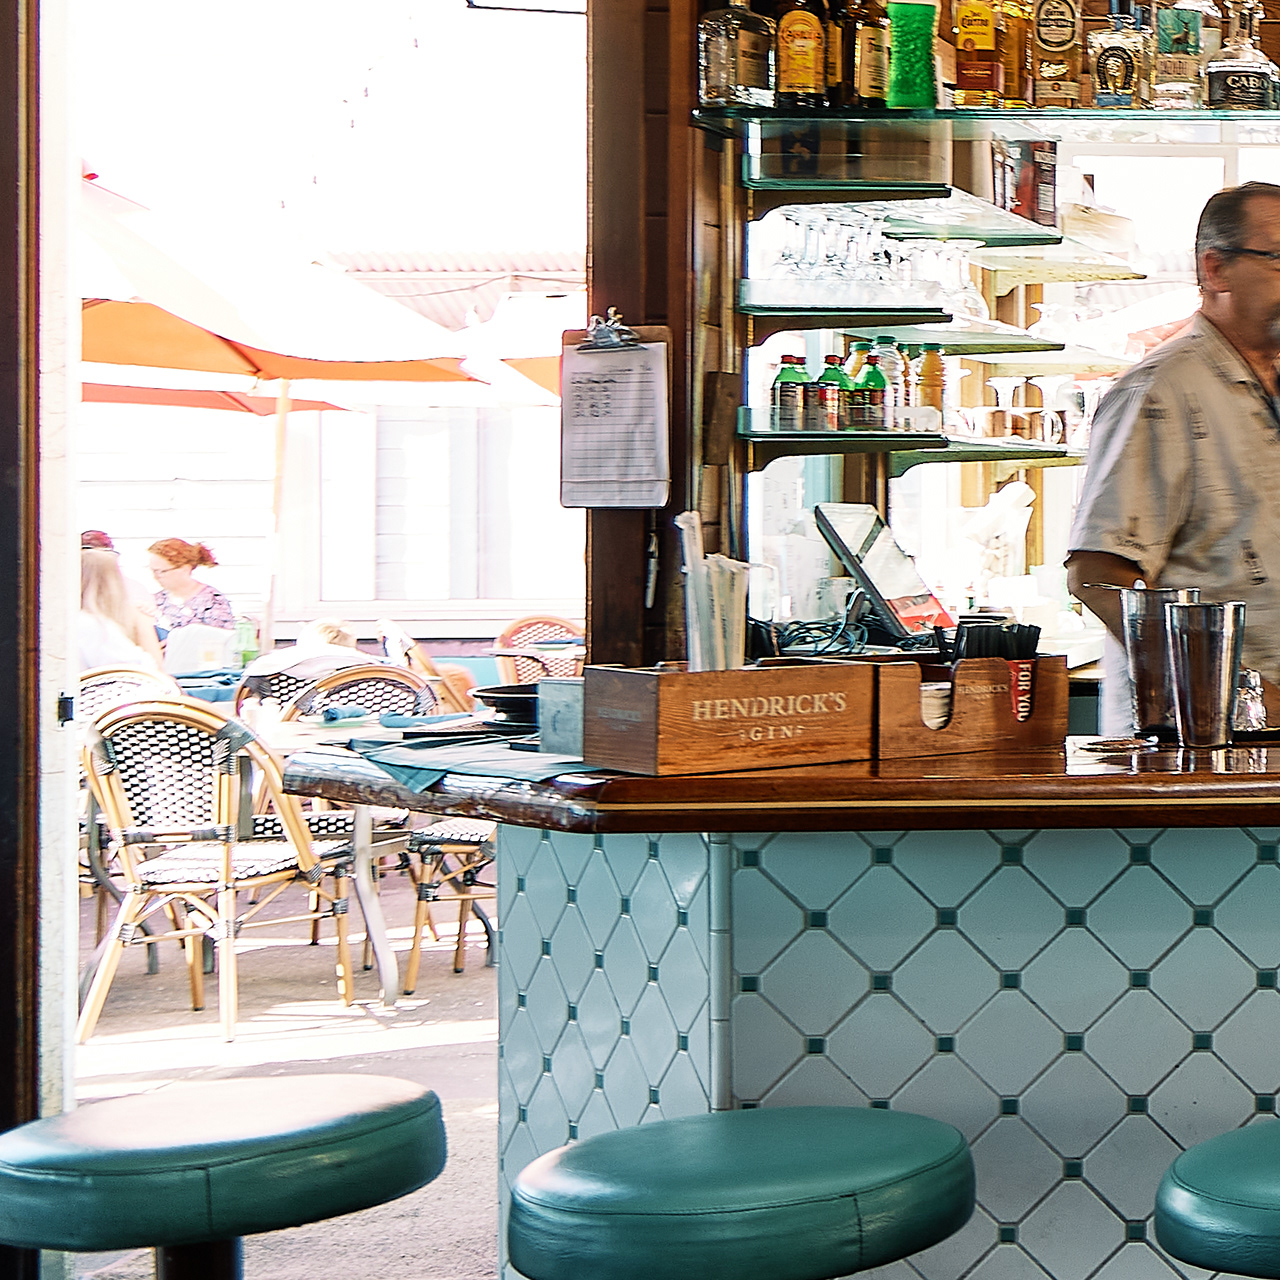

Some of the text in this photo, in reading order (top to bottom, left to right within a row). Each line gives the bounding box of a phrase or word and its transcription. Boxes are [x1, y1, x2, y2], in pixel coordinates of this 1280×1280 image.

[1017, 663, 1032, 691] FOR
[692, 691, 848, 721] HENDRICK'S
[750, 725, 794, 741] GIN
